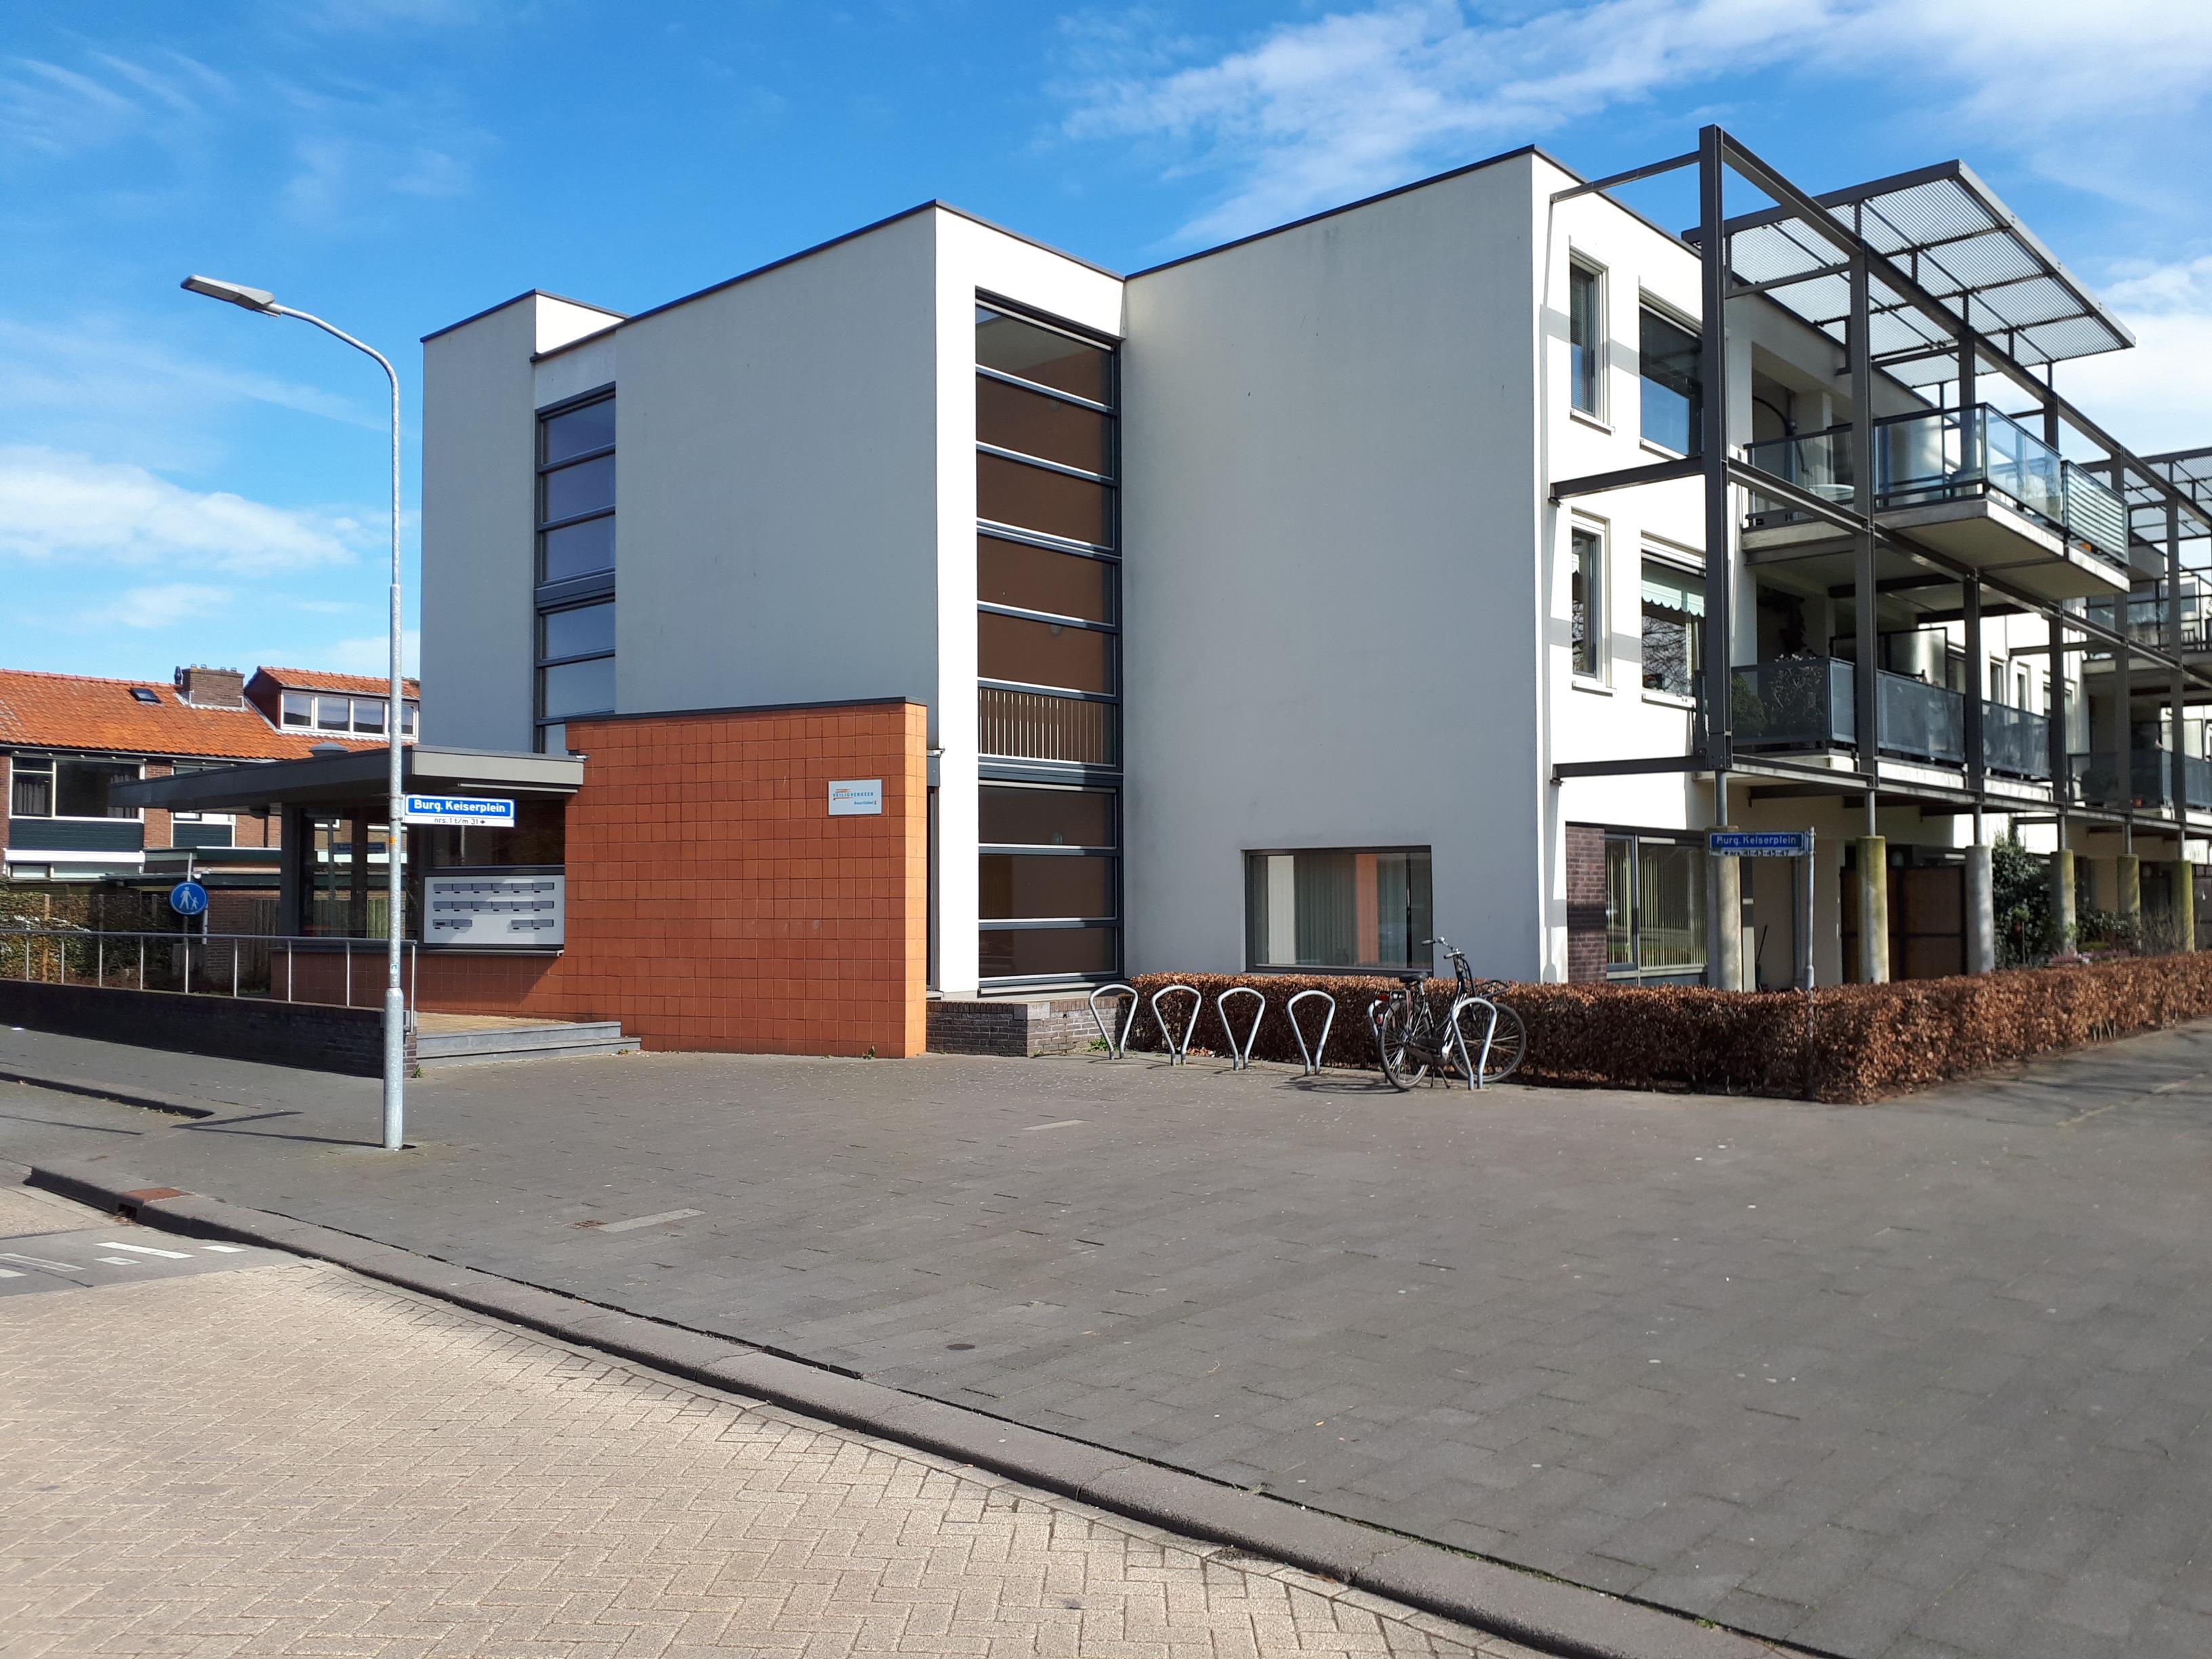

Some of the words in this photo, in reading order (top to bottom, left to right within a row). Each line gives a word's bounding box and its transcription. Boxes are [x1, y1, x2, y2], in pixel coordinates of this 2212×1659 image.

[413, 799, 443, 813] Burg.
[445, 800, 506, 813] Keiserplein
[1717, 836, 1740, 846] Burg.
[1743, 836, 1796, 845] Keiserplein
